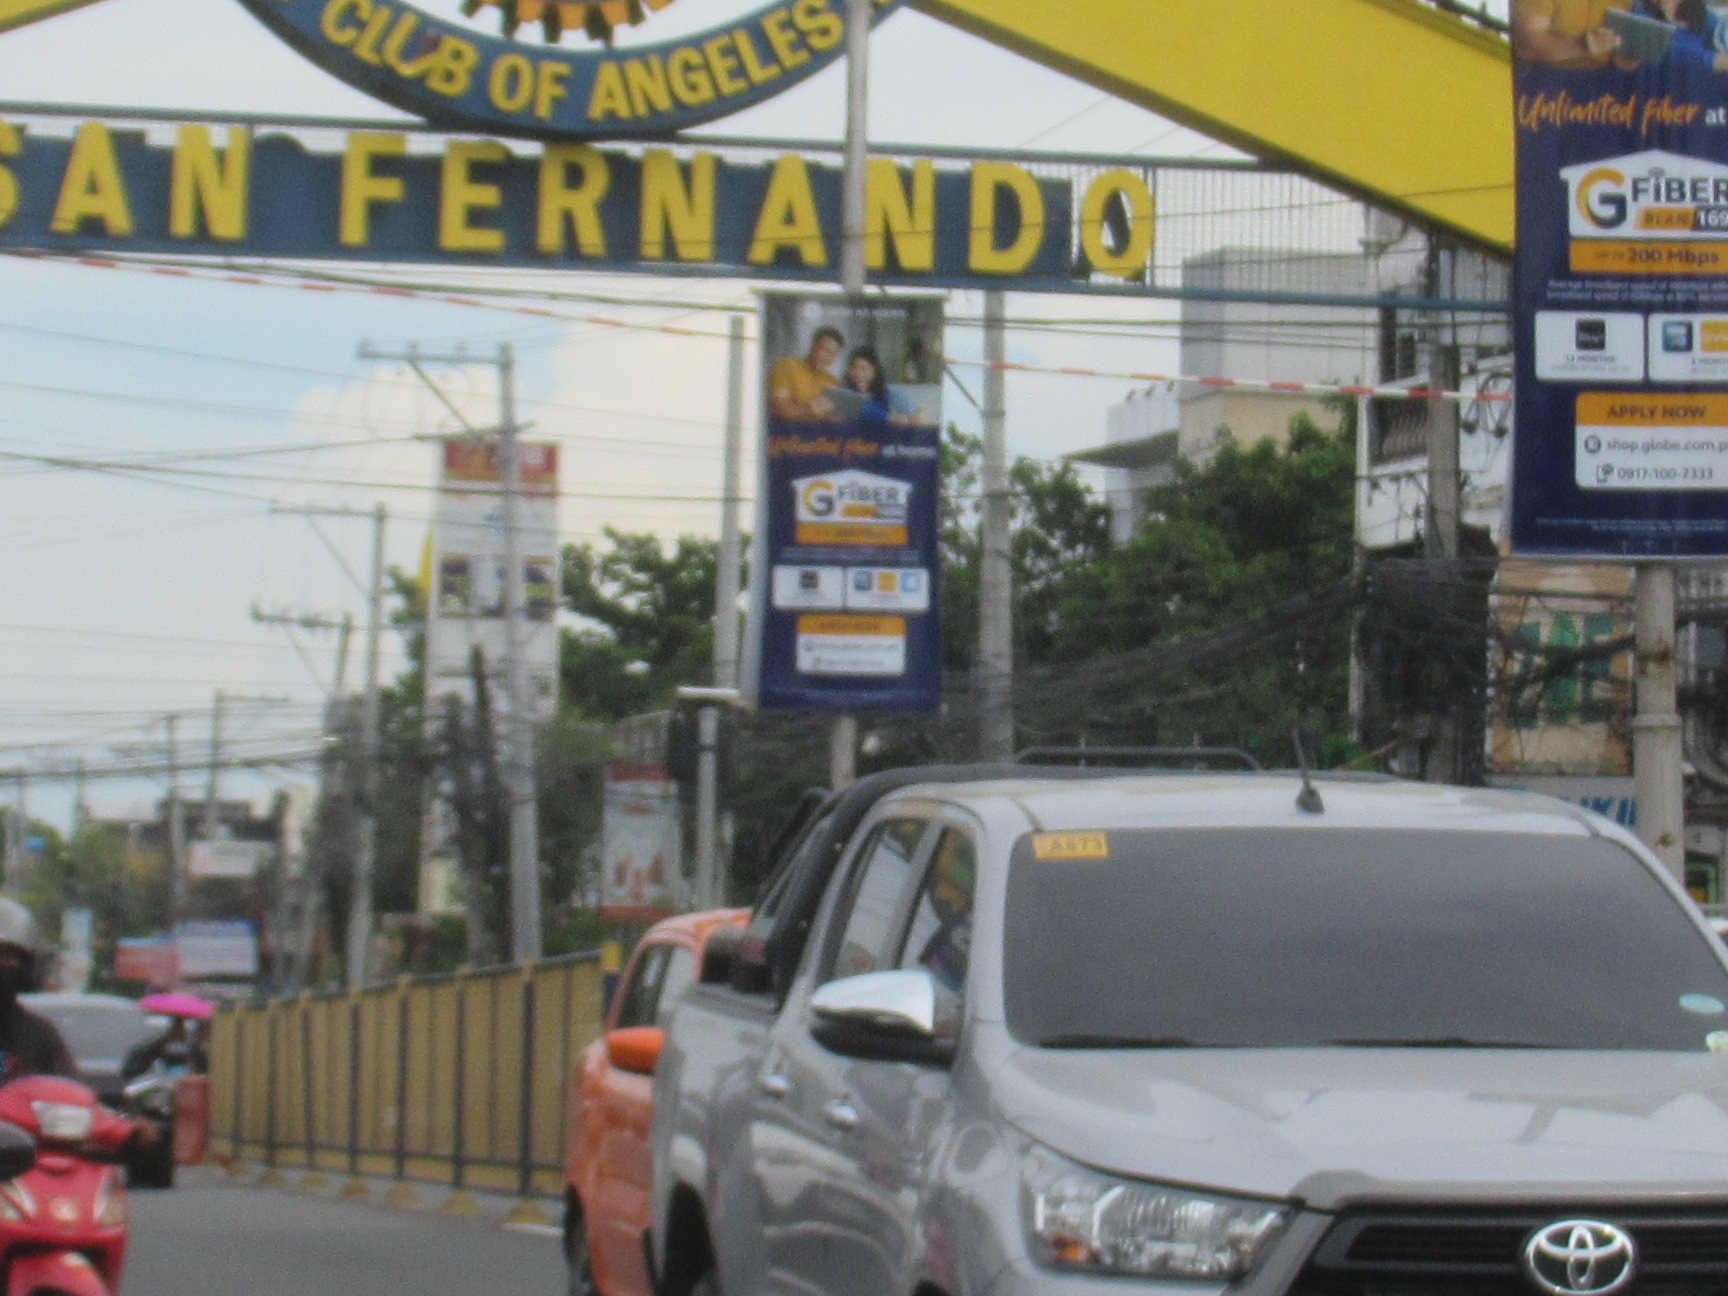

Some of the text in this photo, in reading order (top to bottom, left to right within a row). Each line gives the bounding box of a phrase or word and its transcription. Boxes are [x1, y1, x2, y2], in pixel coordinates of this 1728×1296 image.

[487, 53, 571, 119] OF
[1705, 106, 1727, 126] at
[337, 130, 1156, 279] FERNANDO
[1668, 248, 1720, 267] Mbps
[1607, 406, 1707, 419] APPLY NOW
